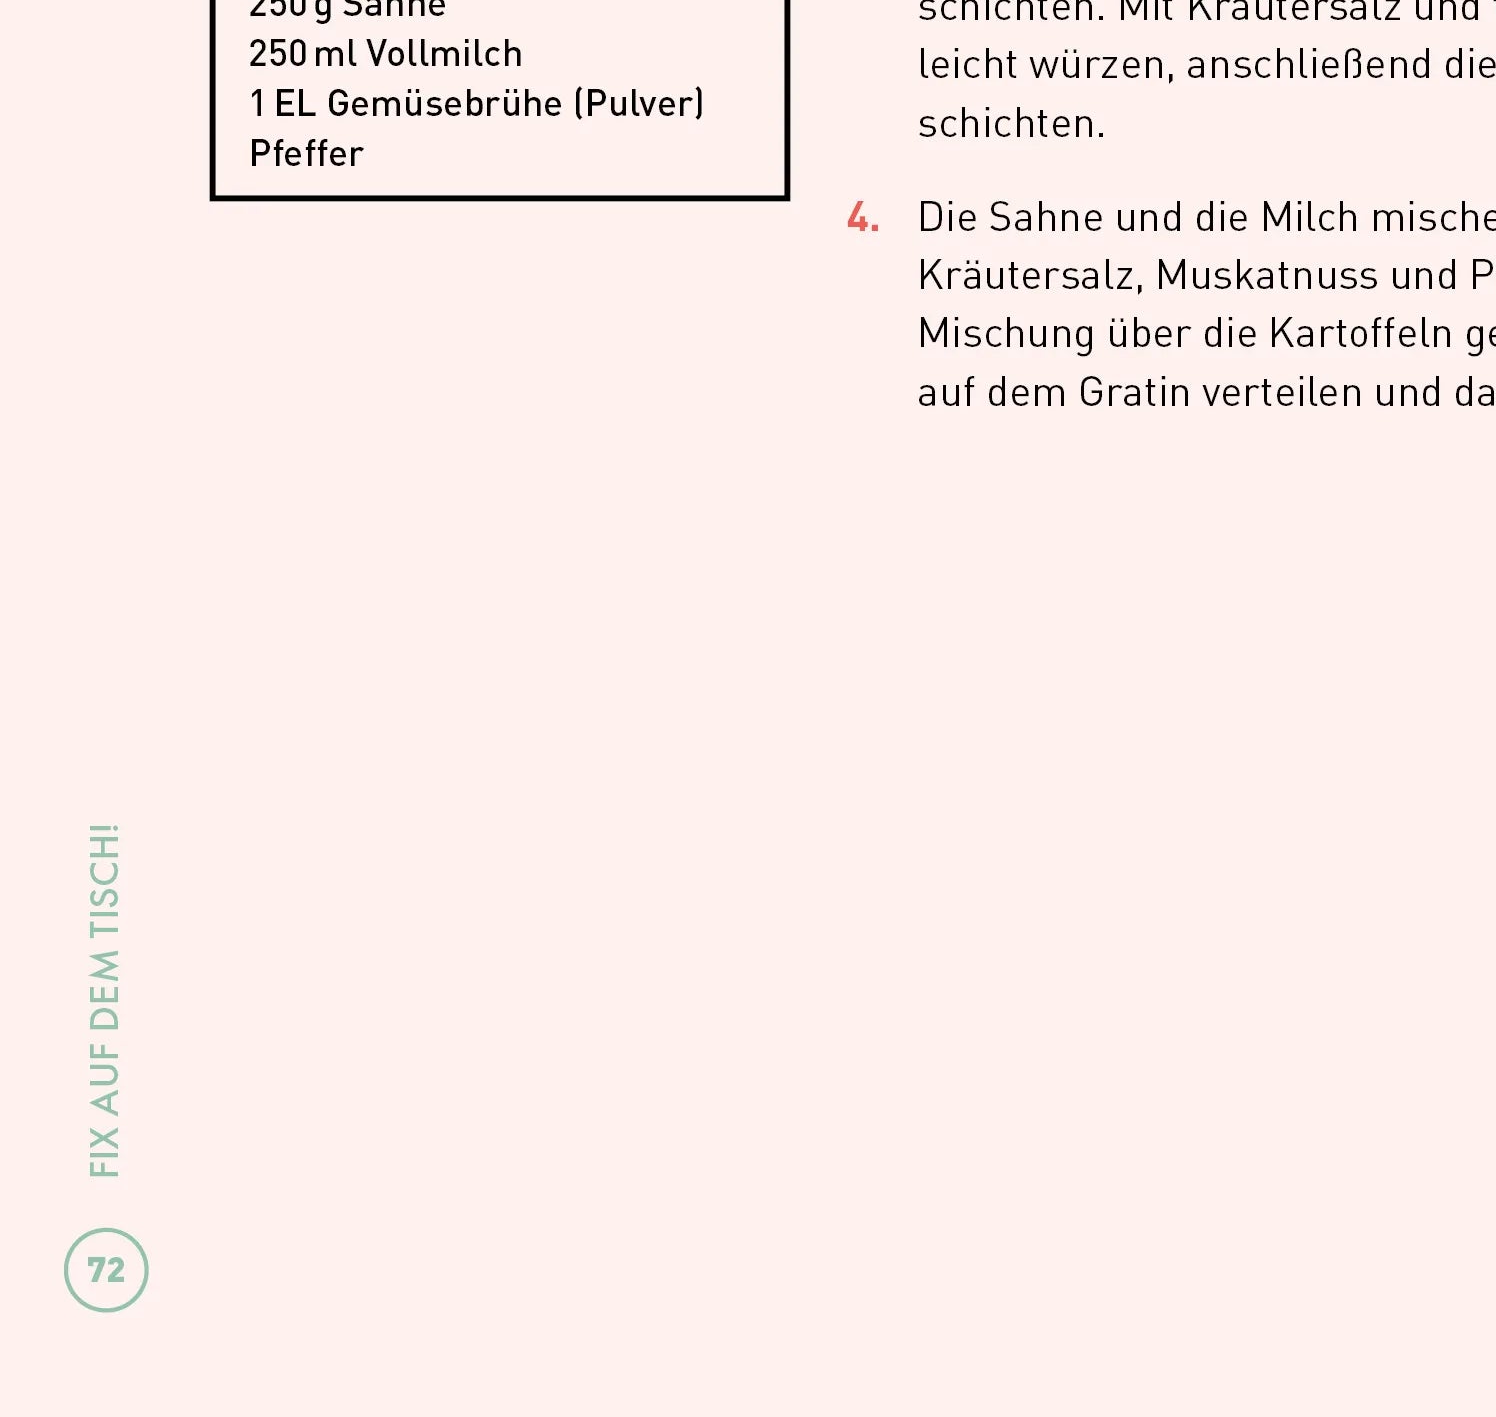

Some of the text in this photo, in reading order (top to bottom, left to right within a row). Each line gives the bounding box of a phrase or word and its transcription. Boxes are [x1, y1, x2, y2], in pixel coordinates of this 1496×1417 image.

[249, 38, 522, 67] 250 ml Vollmilch
[920, 47, 1018, 79] leicht
[1028, 48, 1174, 85] würzen,
[1187, 47, 1430, 79] anschließend
[1445, 47, 1496, 79] die
[251, 85, 703, 121] 1 EL Gemüsebrühe (Pulver)
[918, 106, 1104, 138] schichten.
[251, 138, 365, 167] Pfeffer
[847, 200, 879, 232] 4.
[920, 200, 977, 232] Die
[989, 200, 1103, 232] Sahne
[1117, 200, 1181, 232] und
[1196, 199, 1248, 233] die
[1263, 200, 1357, 233] Milch
[920, 258, 1143, 296] Kräutersalz,
[1158, 258, 1378, 290] Muskatnuss
[1392, 258, 1456, 290] und
[920, 316, 1093, 358] Mischung
[1109, 316, 1193, 348] über
[1204, 316, 1257, 348] die
[1271, 316, 1451, 348] Kartoffeln
[918, 375, 976, 407] auf
[988, 375, 1065, 407] dem
[1080, 375, 1189, 407] Gratin
[1201, 375, 1361, 407] verteilen
[1376, 375, 1440, 407] und
[87, 824, 119, 1177] FIX AUF DEM TISCH!
[87, 1256, 125, 1283] 72
